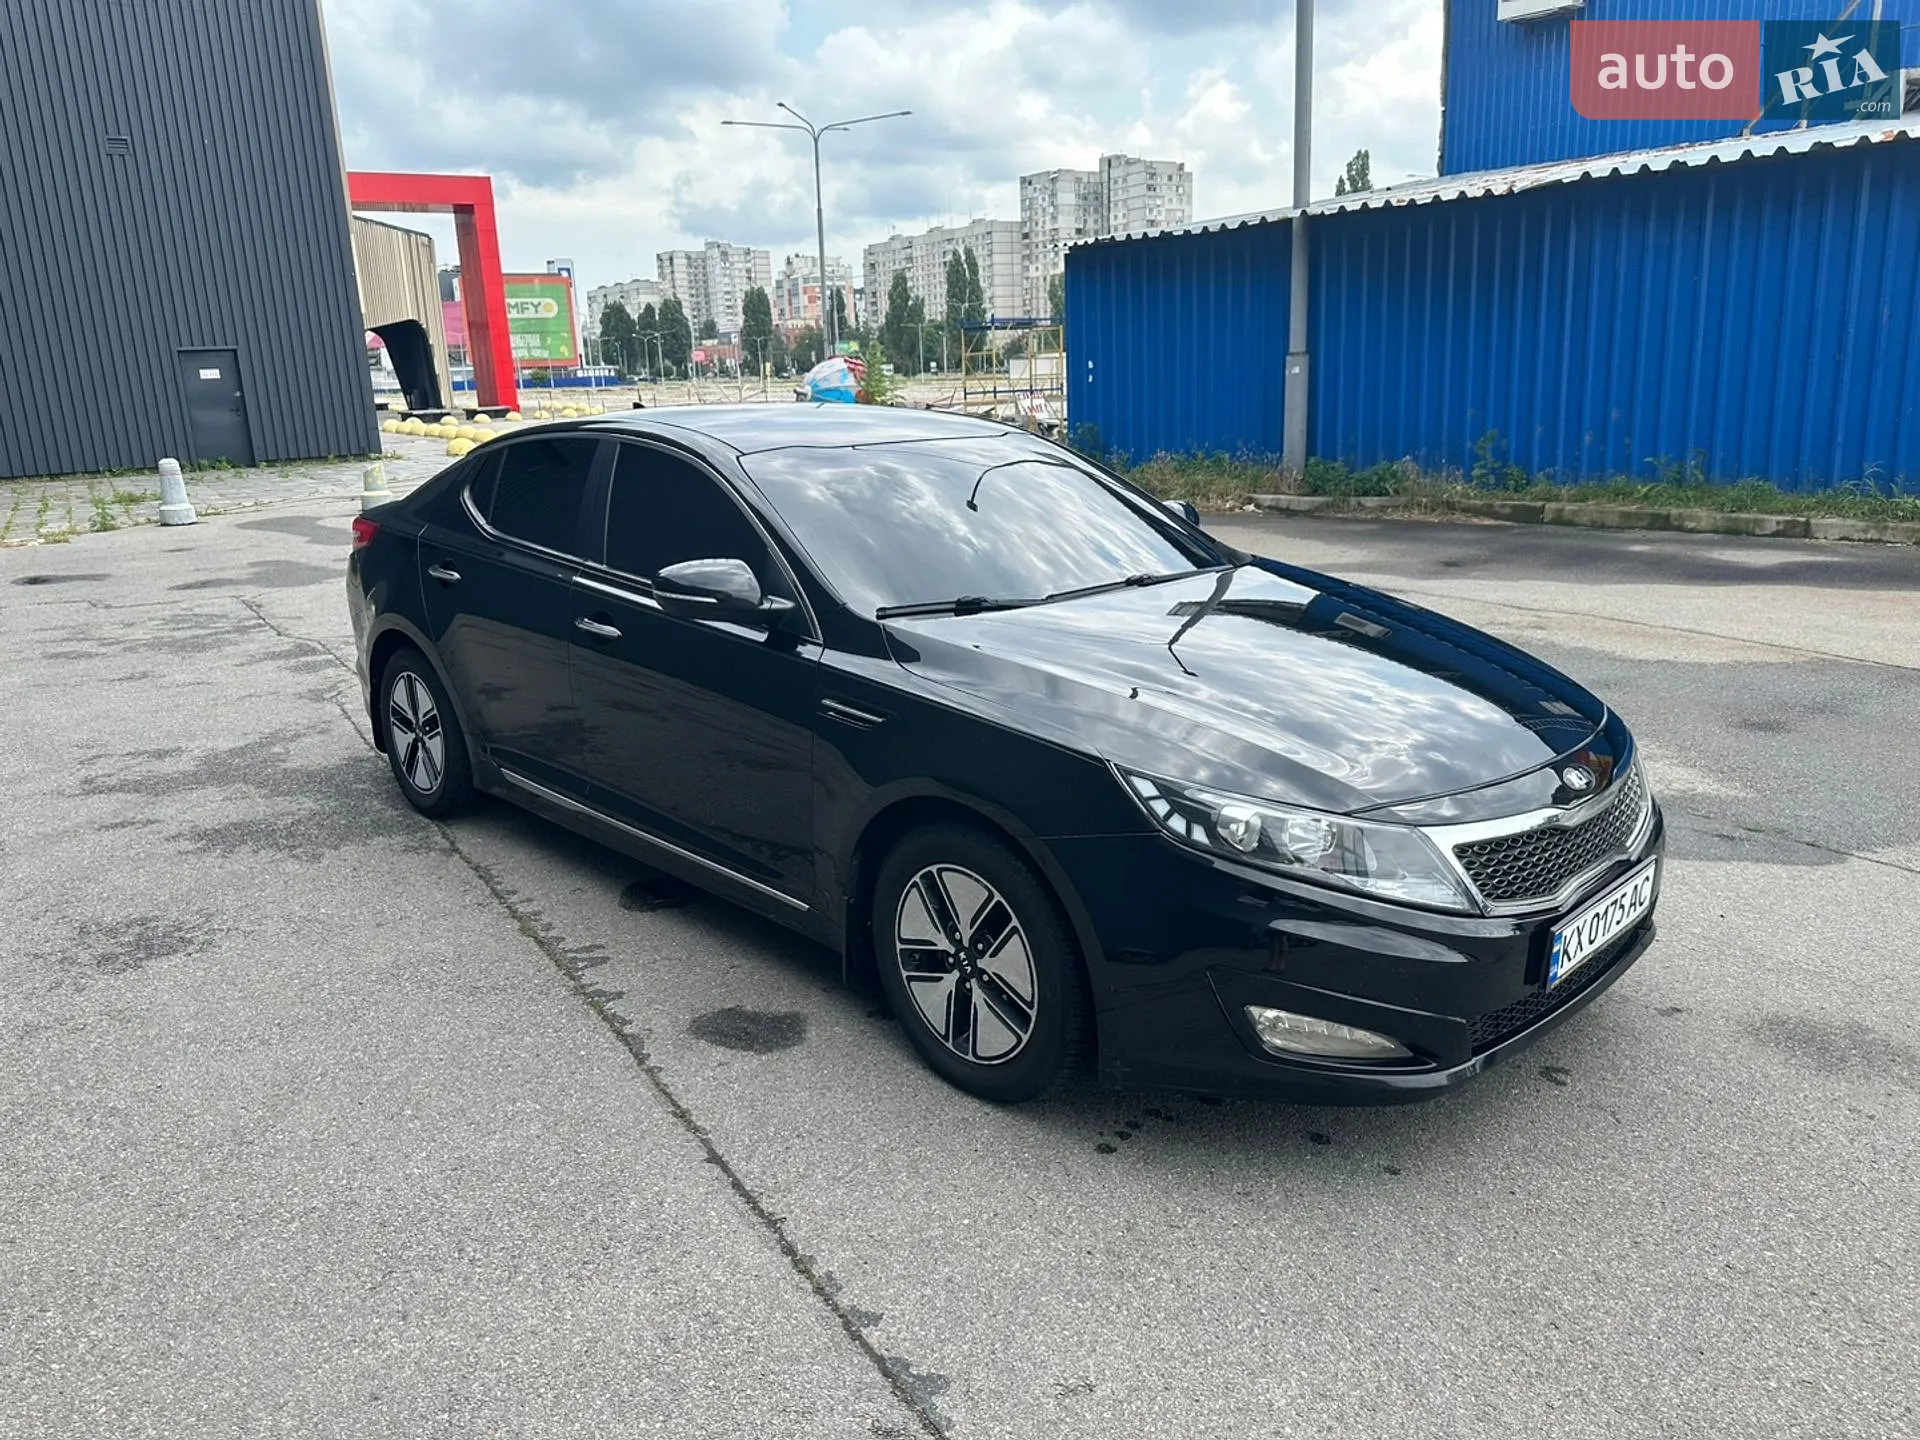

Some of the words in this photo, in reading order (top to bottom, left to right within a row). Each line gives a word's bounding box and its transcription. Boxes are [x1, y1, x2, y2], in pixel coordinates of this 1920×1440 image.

[1560, 918, 1588, 969] KX
[1588, 891, 1628, 945] 0175
[1627, 875, 1650, 918] AC
